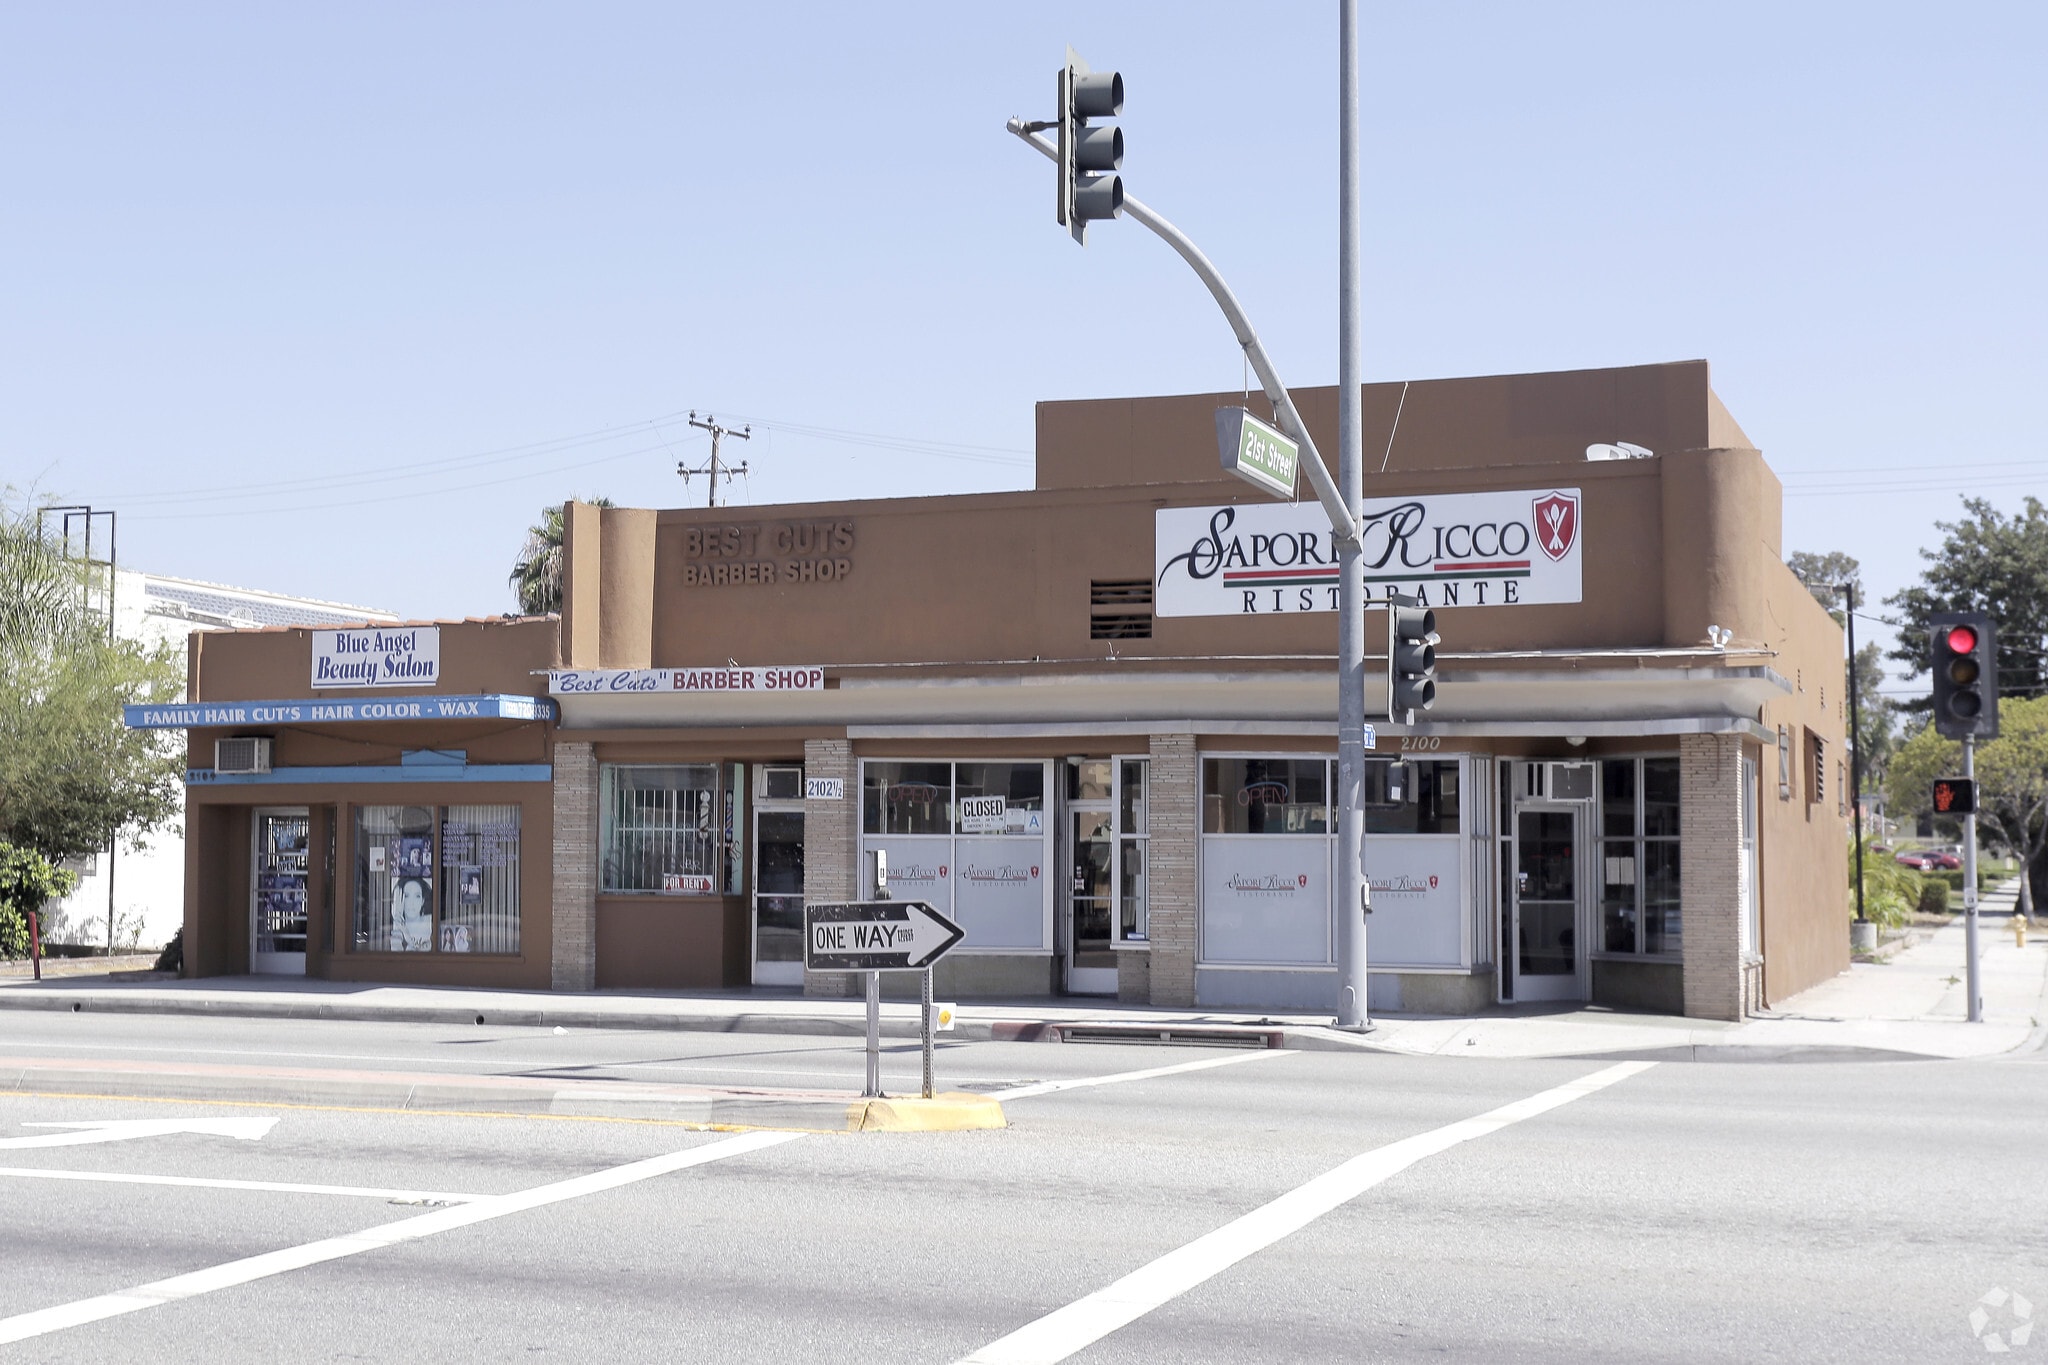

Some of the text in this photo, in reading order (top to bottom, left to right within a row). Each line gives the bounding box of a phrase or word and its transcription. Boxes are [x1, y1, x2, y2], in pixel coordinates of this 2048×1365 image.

[1245, 430, 1293, 479] 21st Street
[683, 521, 854, 558] BEST CUTS
[1363, 502, 1530, 569] RICCO
[683, 558, 851, 587] BARBER SHOP
[336, 630, 416, 656] Blue Angel
[317, 653, 434, 685] Beauty Salon
[673, 672, 755, 690] BARBER
[765, 667, 822, 689] SHOP
[143, 710, 200, 725] FAMILY
[205, 708, 246, 723] HAIR
[252, 706, 301, 721] CUT'S
[311, 704, 354, 719] HAIR
[360, 703, 421, 718] COLOR
[438, 702, 479, 716] WAX
[1401, 736, 1441, 751] 2100
[888, 785, 936, 804] OPEN
[1238, 786, 1286, 806] OPEN
[963, 799, 1003, 817] CLOSED
[1029, 815, 1040, 828] A
[278, 861, 296, 872] OPEN
[665, 876, 704, 889] FOR RENT
[816, 925, 846, 950] ONE
[853, 924, 898, 949] WAY
